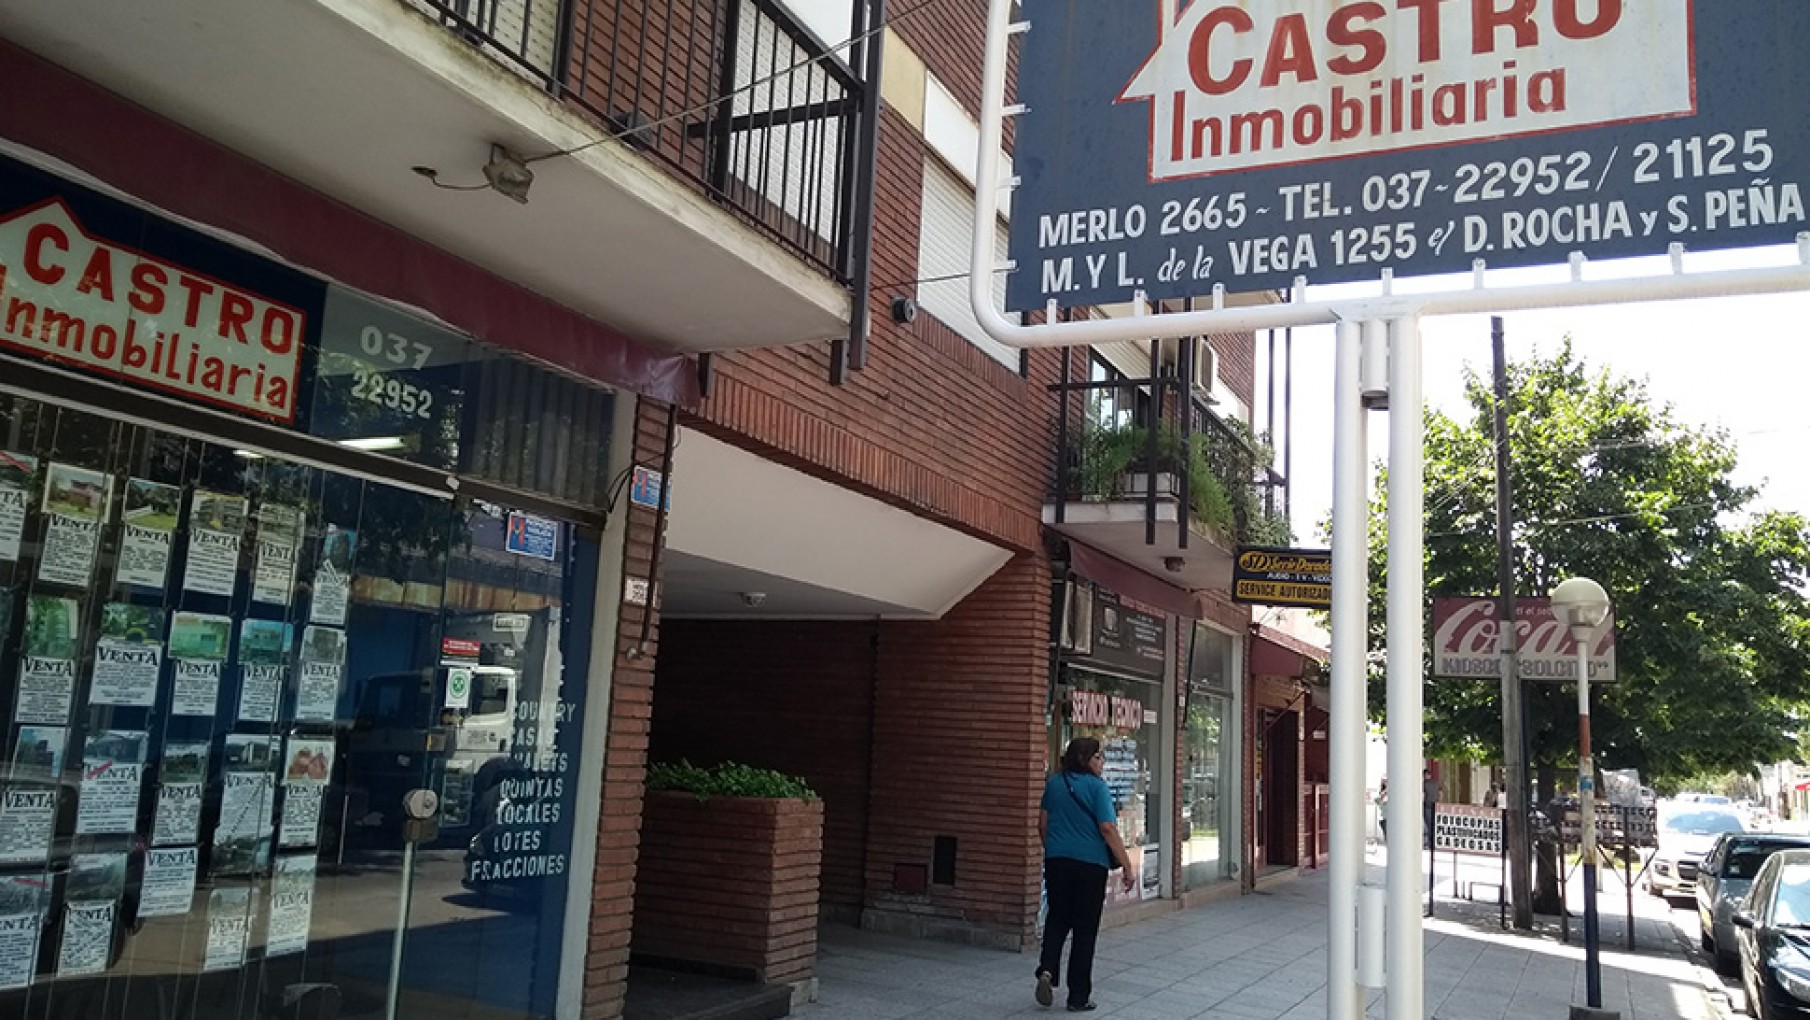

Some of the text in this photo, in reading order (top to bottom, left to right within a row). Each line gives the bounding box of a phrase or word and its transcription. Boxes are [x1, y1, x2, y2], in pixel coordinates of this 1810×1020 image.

[1170, 60, 1566, 162] Inmobiliaria
[1038, 204, 1147, 248] MERLO
[1160, 192, 1247, 236] 2665
[1278, 181, 1352, 222] TEL.
[1632, 128, 1774, 184] 21125
[1117, 251, 1145, 286] L.
[1158, 247, 1185, 283] de
[1191, 244, 1214, 280] la
[1228, 233, 1319, 276] VEGA
[1330, 221, 1417, 266] 1255
[1463, 215, 1494, 253] D.
[1502, 201, 1634, 249] ROCHA
[1667, 193, 1698, 234] S.
[1705, 177, 1806, 230] PEÑA
[23, 222, 295, 355] CASTRO
[359, 325, 435, 370] 037
[351, 368, 434, 420] 22952
[127, 525, 169, 545] VENTA
[193, 527, 238, 551] VENTA
[1239, 582, 1276, 597] SERVICE
[24, 655, 73, 677] VENTA
[98, 646, 158, 666] VENTA
[176, 658, 218, 677] VENTA
[162, 783, 201, 799] VENTA
[227, 774, 273, 789] VENA
[500, 777, 564, 800] QUINTAS
[5, 791, 55, 808] VENTA
[496, 802, 561, 826] LOCALES
[494, 830, 542, 853] LOTES
[149, 849, 196, 866] VENTA
[470, 853, 566, 882] FRACCIONES
